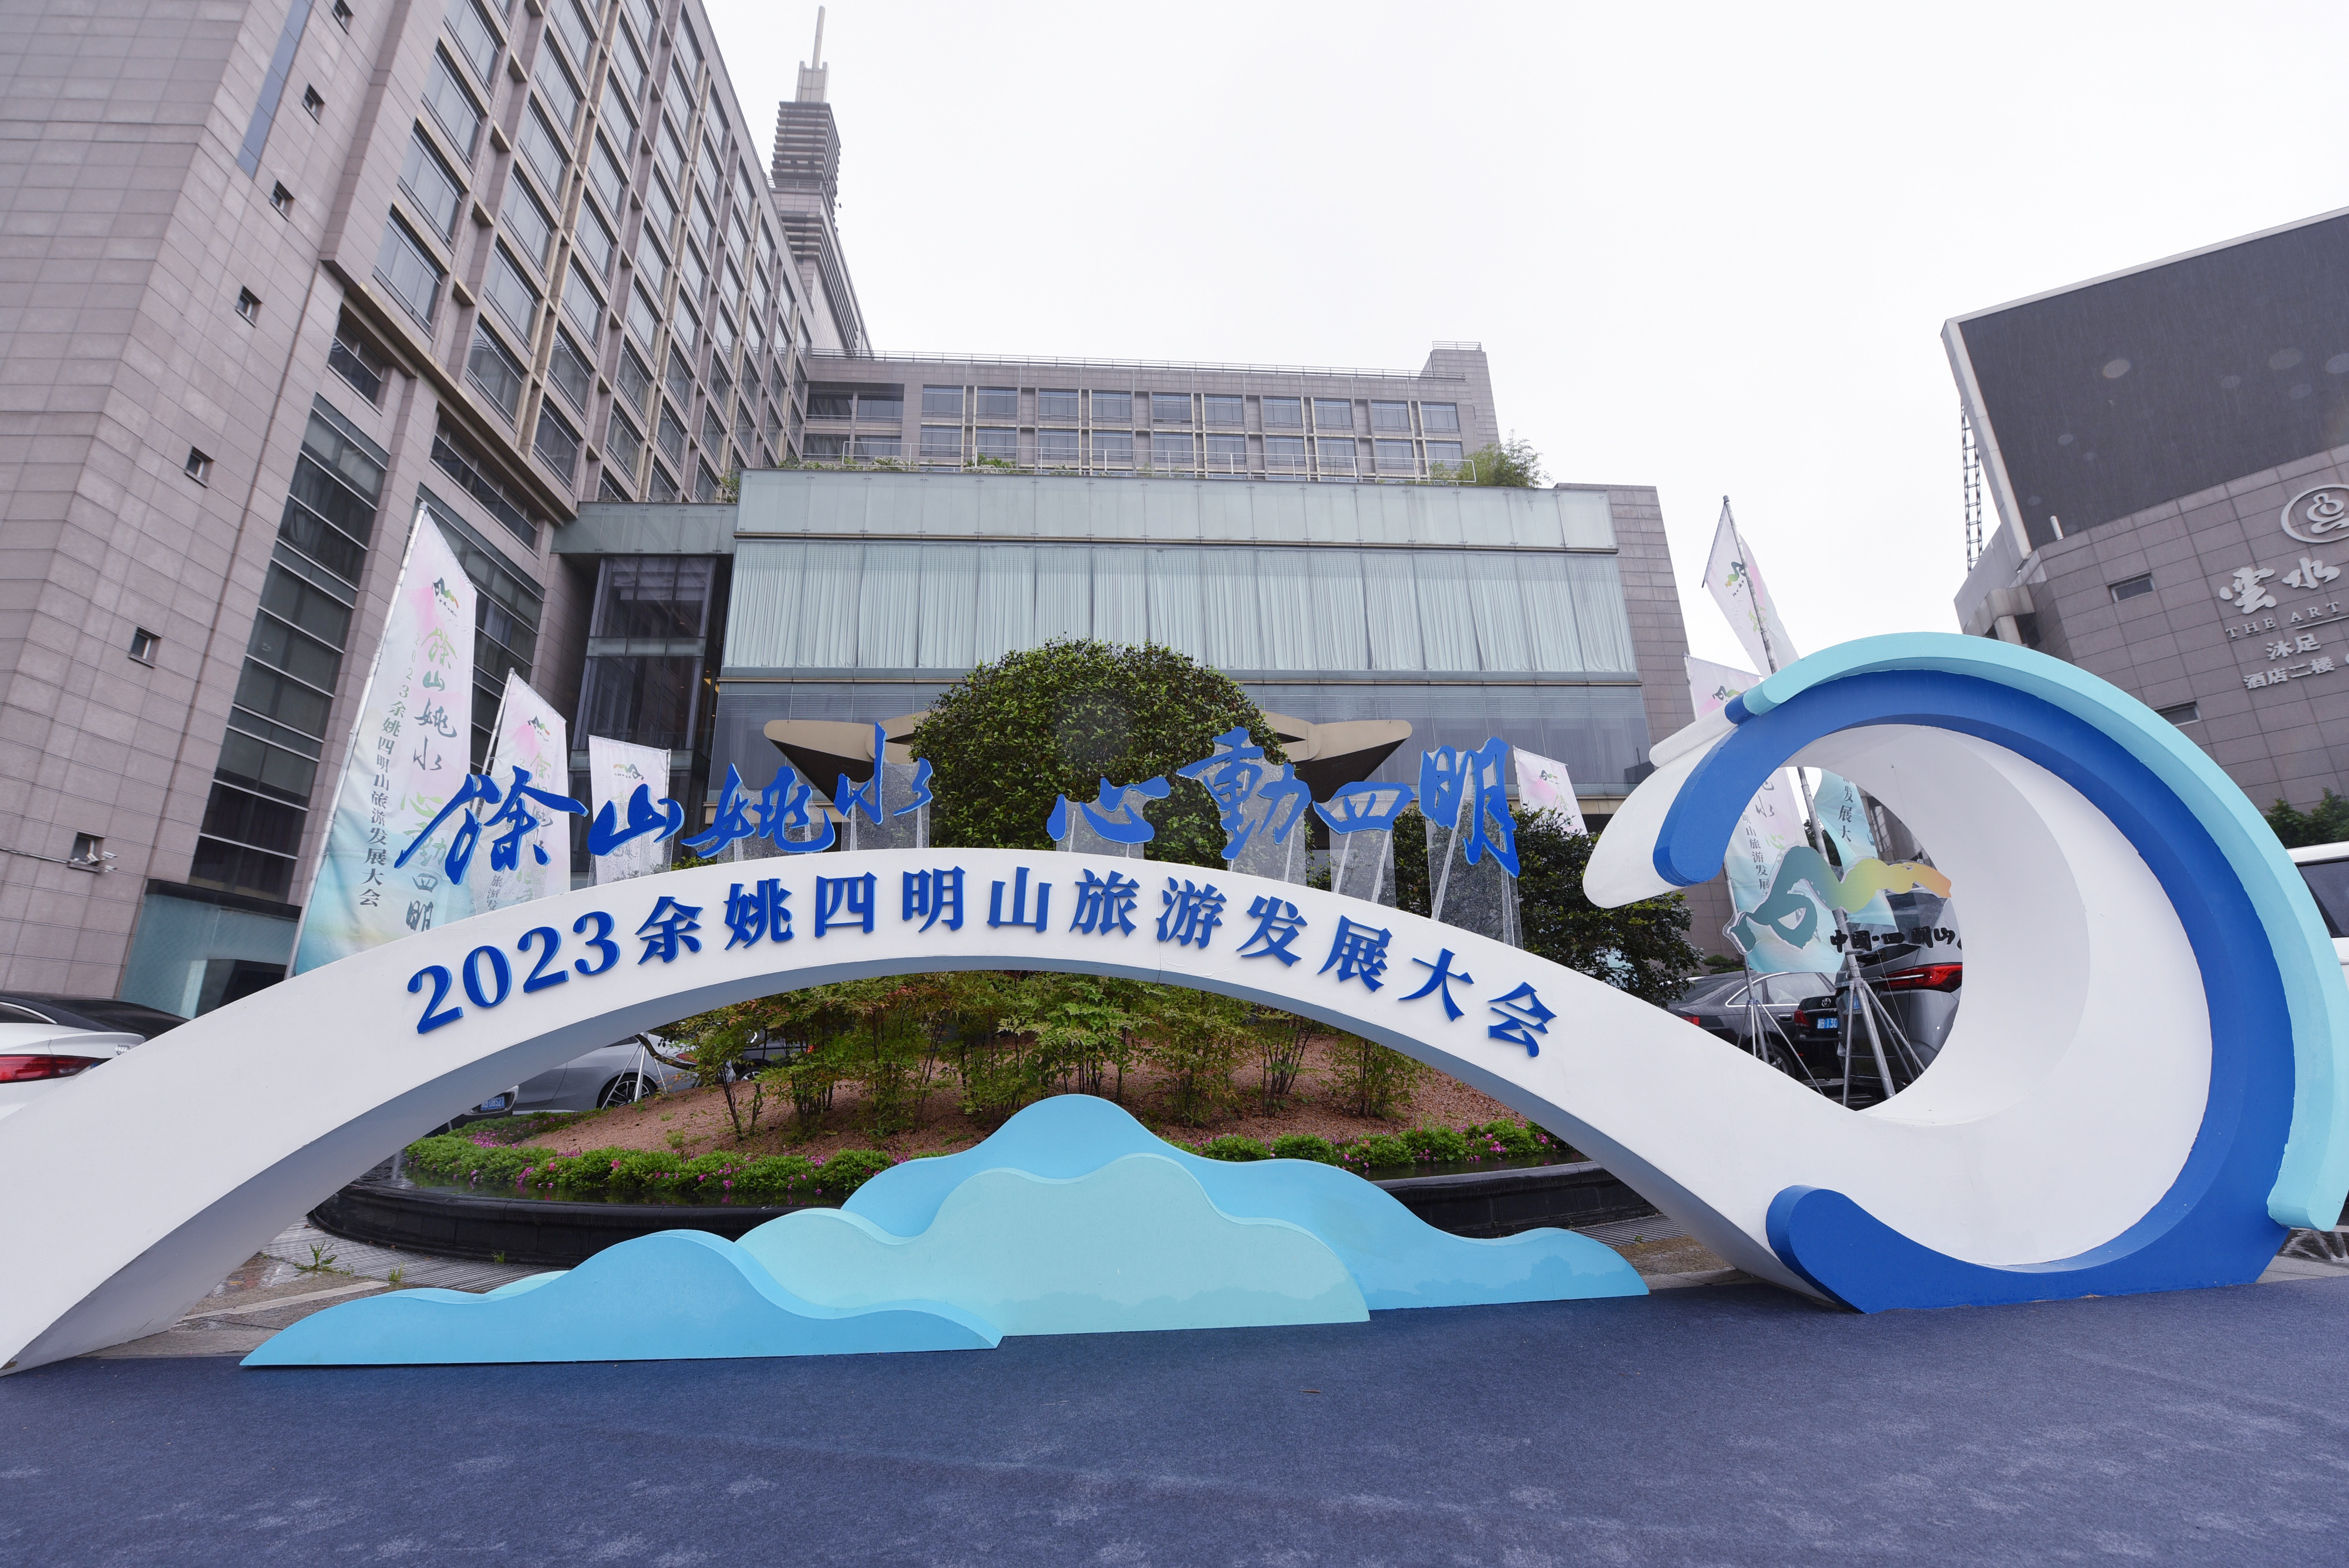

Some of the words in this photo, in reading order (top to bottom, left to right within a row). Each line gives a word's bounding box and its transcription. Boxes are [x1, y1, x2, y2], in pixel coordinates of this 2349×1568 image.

[2226, 617, 2276, 638] THE
[2290, 601, 2340, 624] ART
[2265, 632, 2321, 661] 沐足
[2243, 655, 2335, 690] 酒店二楼
[407, 865, 1558, 1059] 2023余姚四明山旅游发展大会
